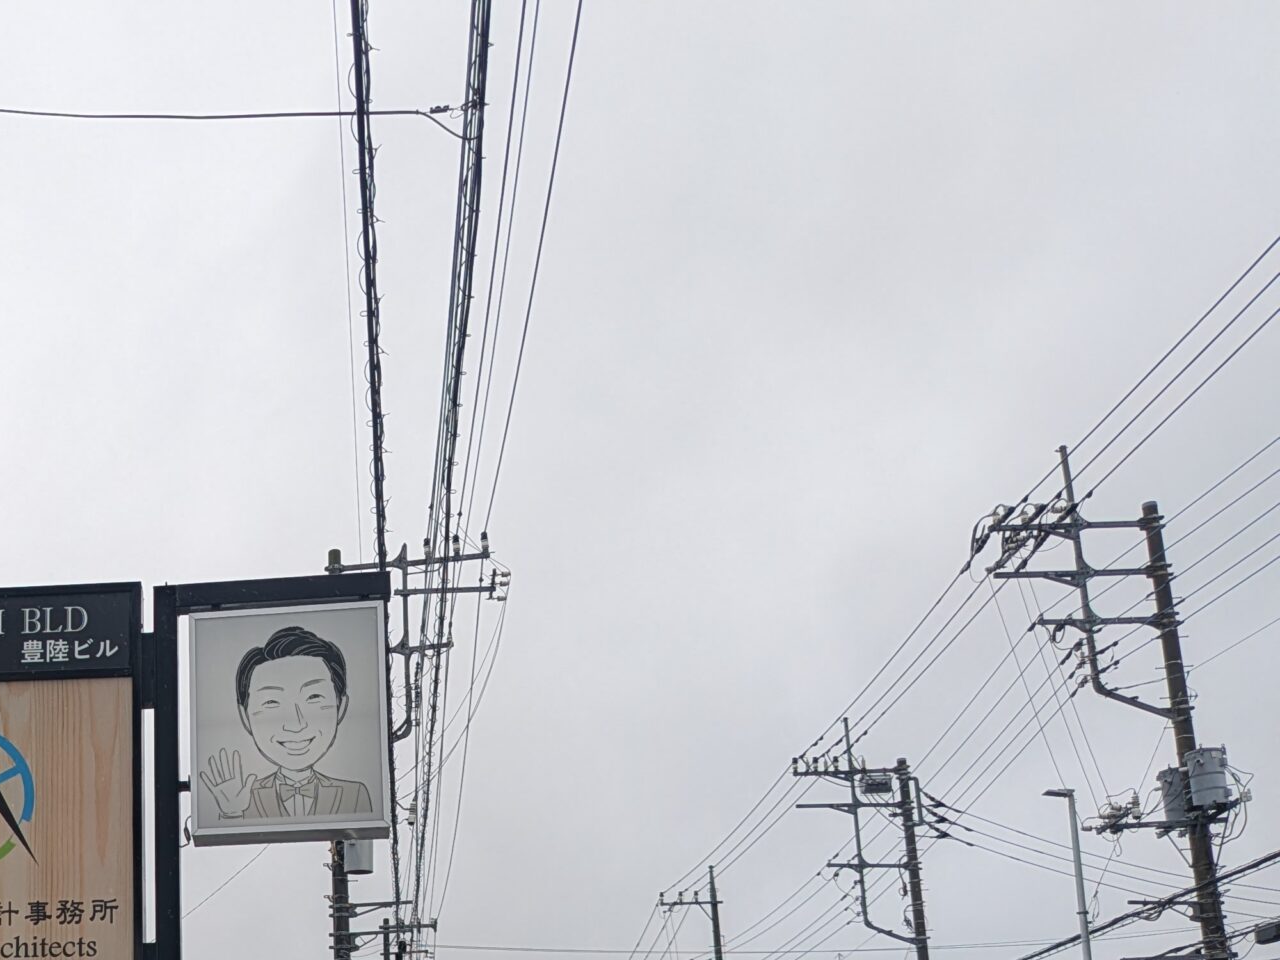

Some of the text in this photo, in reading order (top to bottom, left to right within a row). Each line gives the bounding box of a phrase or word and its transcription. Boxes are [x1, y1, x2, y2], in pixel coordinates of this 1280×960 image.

[20, 605, 89, 635] BLD
[21, 638, 119, 664] 豊陸ビル
